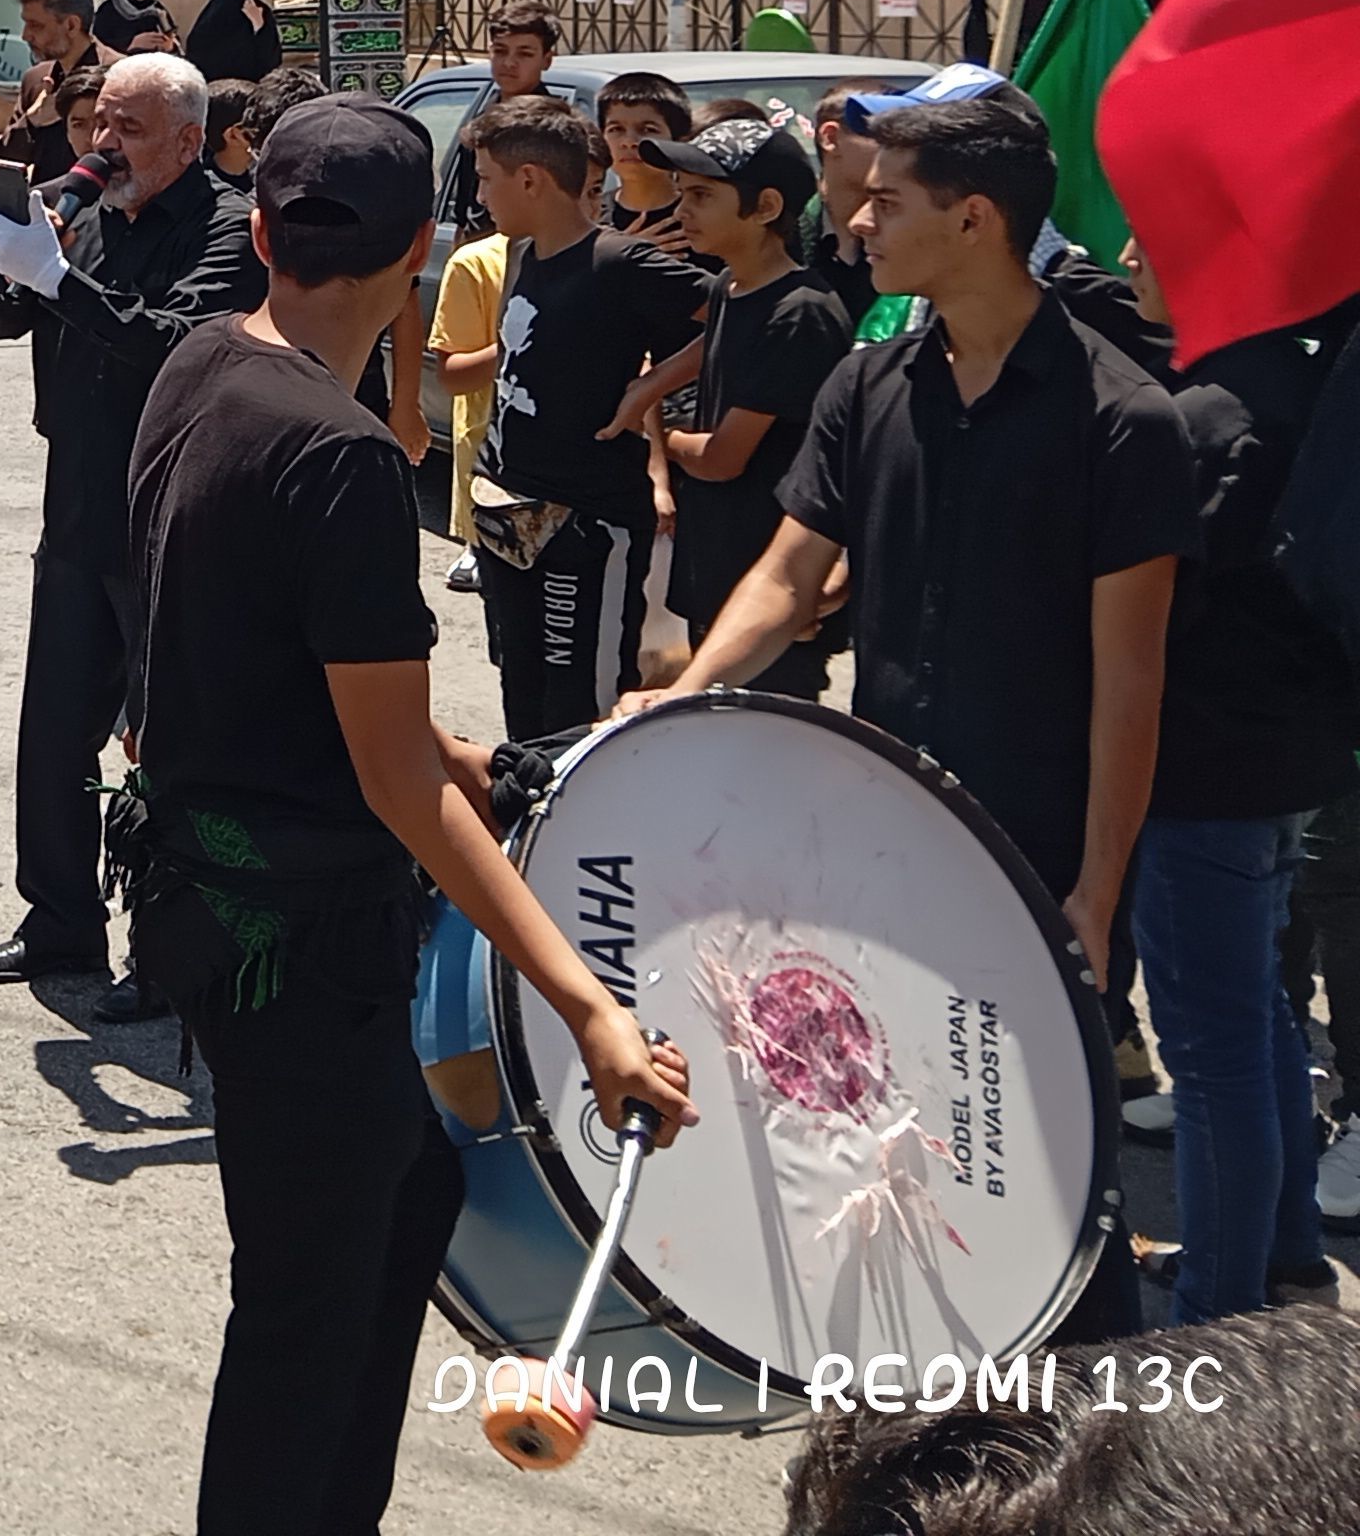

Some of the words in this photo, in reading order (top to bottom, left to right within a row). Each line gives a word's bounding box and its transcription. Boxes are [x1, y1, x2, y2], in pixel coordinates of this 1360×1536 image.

[544, 571, 578, 665] JORDAN
[947, 995, 970, 1080] JAPAN
[978, 999, 1004, 1157] AVAGOSTAR
[952, 1095, 974, 1186] MODEL
[985, 1160, 1006, 1198] BY
